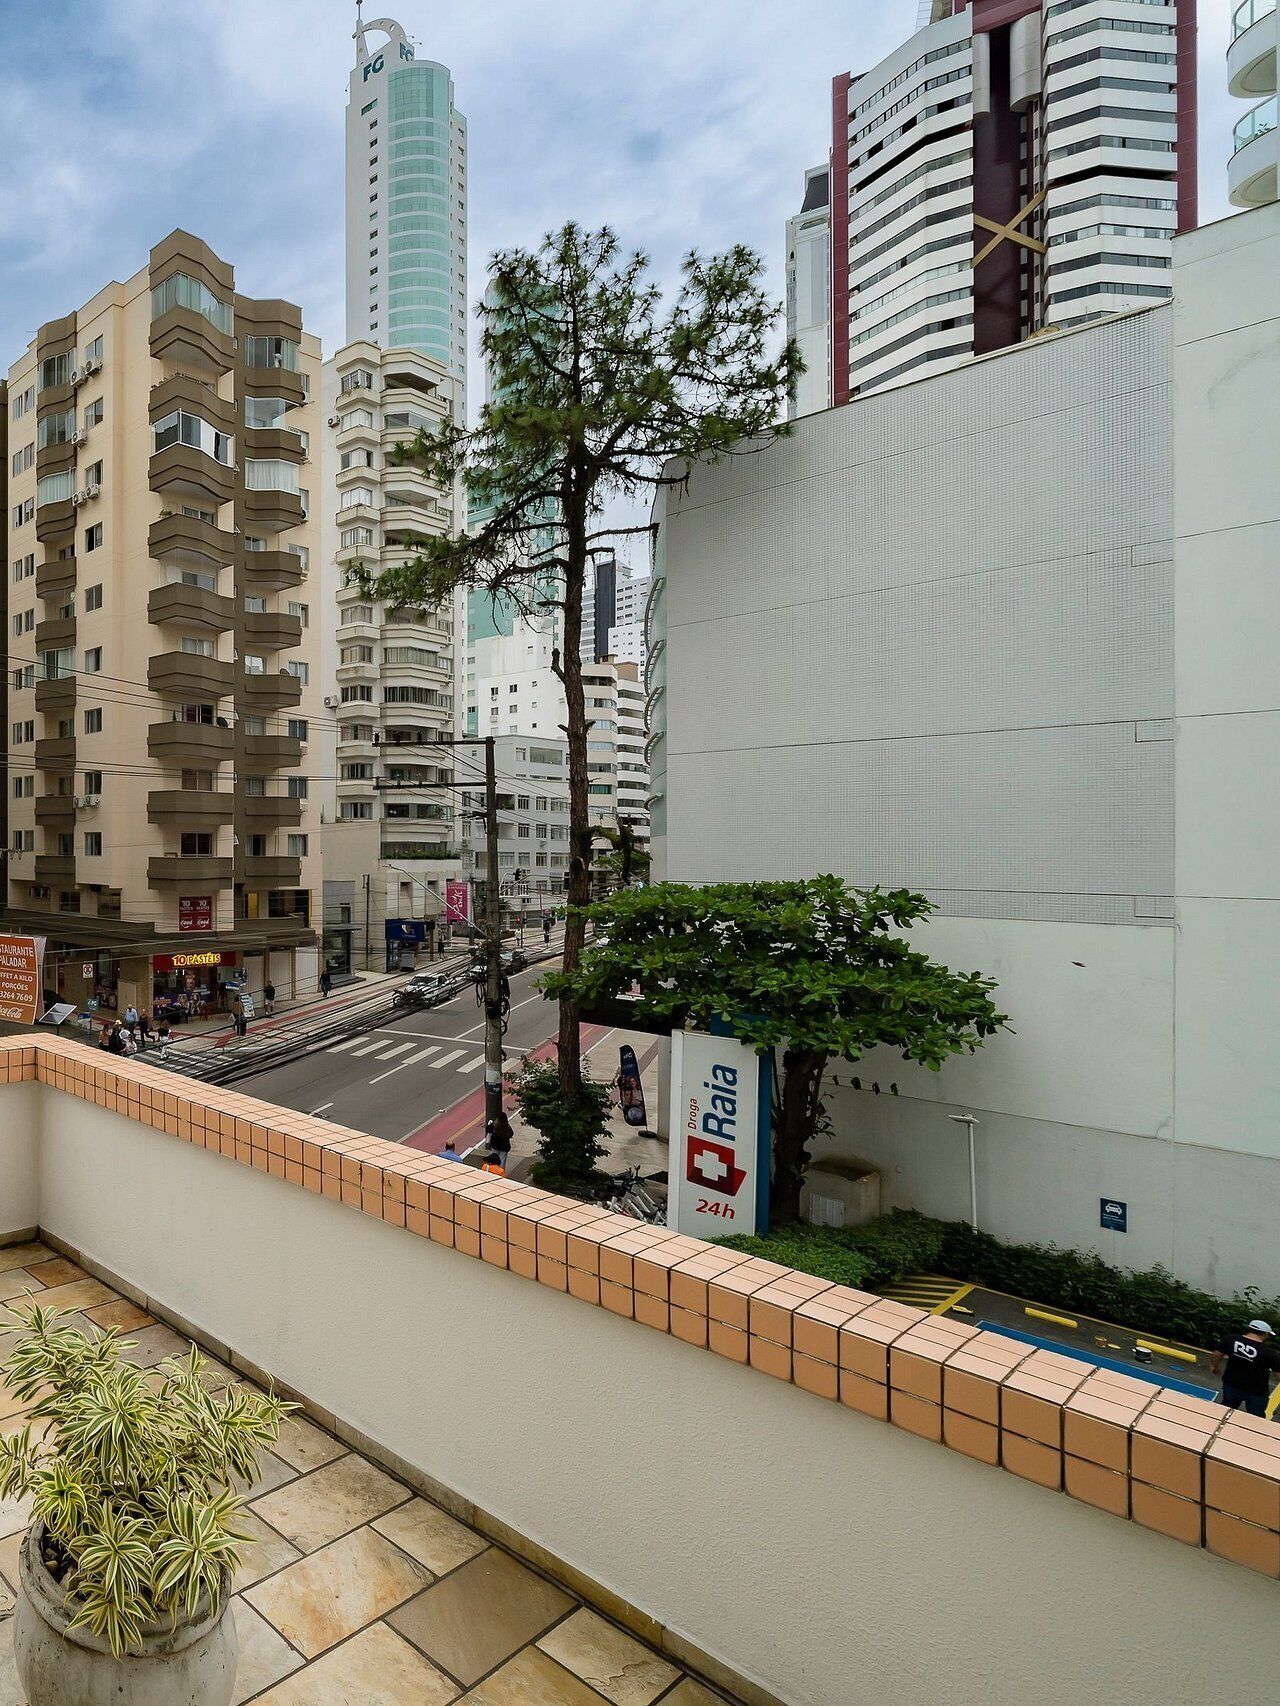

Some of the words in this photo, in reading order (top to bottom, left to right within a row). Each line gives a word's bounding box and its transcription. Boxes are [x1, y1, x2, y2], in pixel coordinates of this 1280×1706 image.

[363, 54, 384, 82] FG
[172, 954, 187, 966] 10
[187, 952, 221, 965] PASTÉIS
[0, 990, 15, 999] 3264
[16, 992, 33, 1001] 7609
[688, 1098, 699, 1130] Droga
[703, 1064, 738, 1142] Raia
[696, 1198, 736, 1220] 24h
